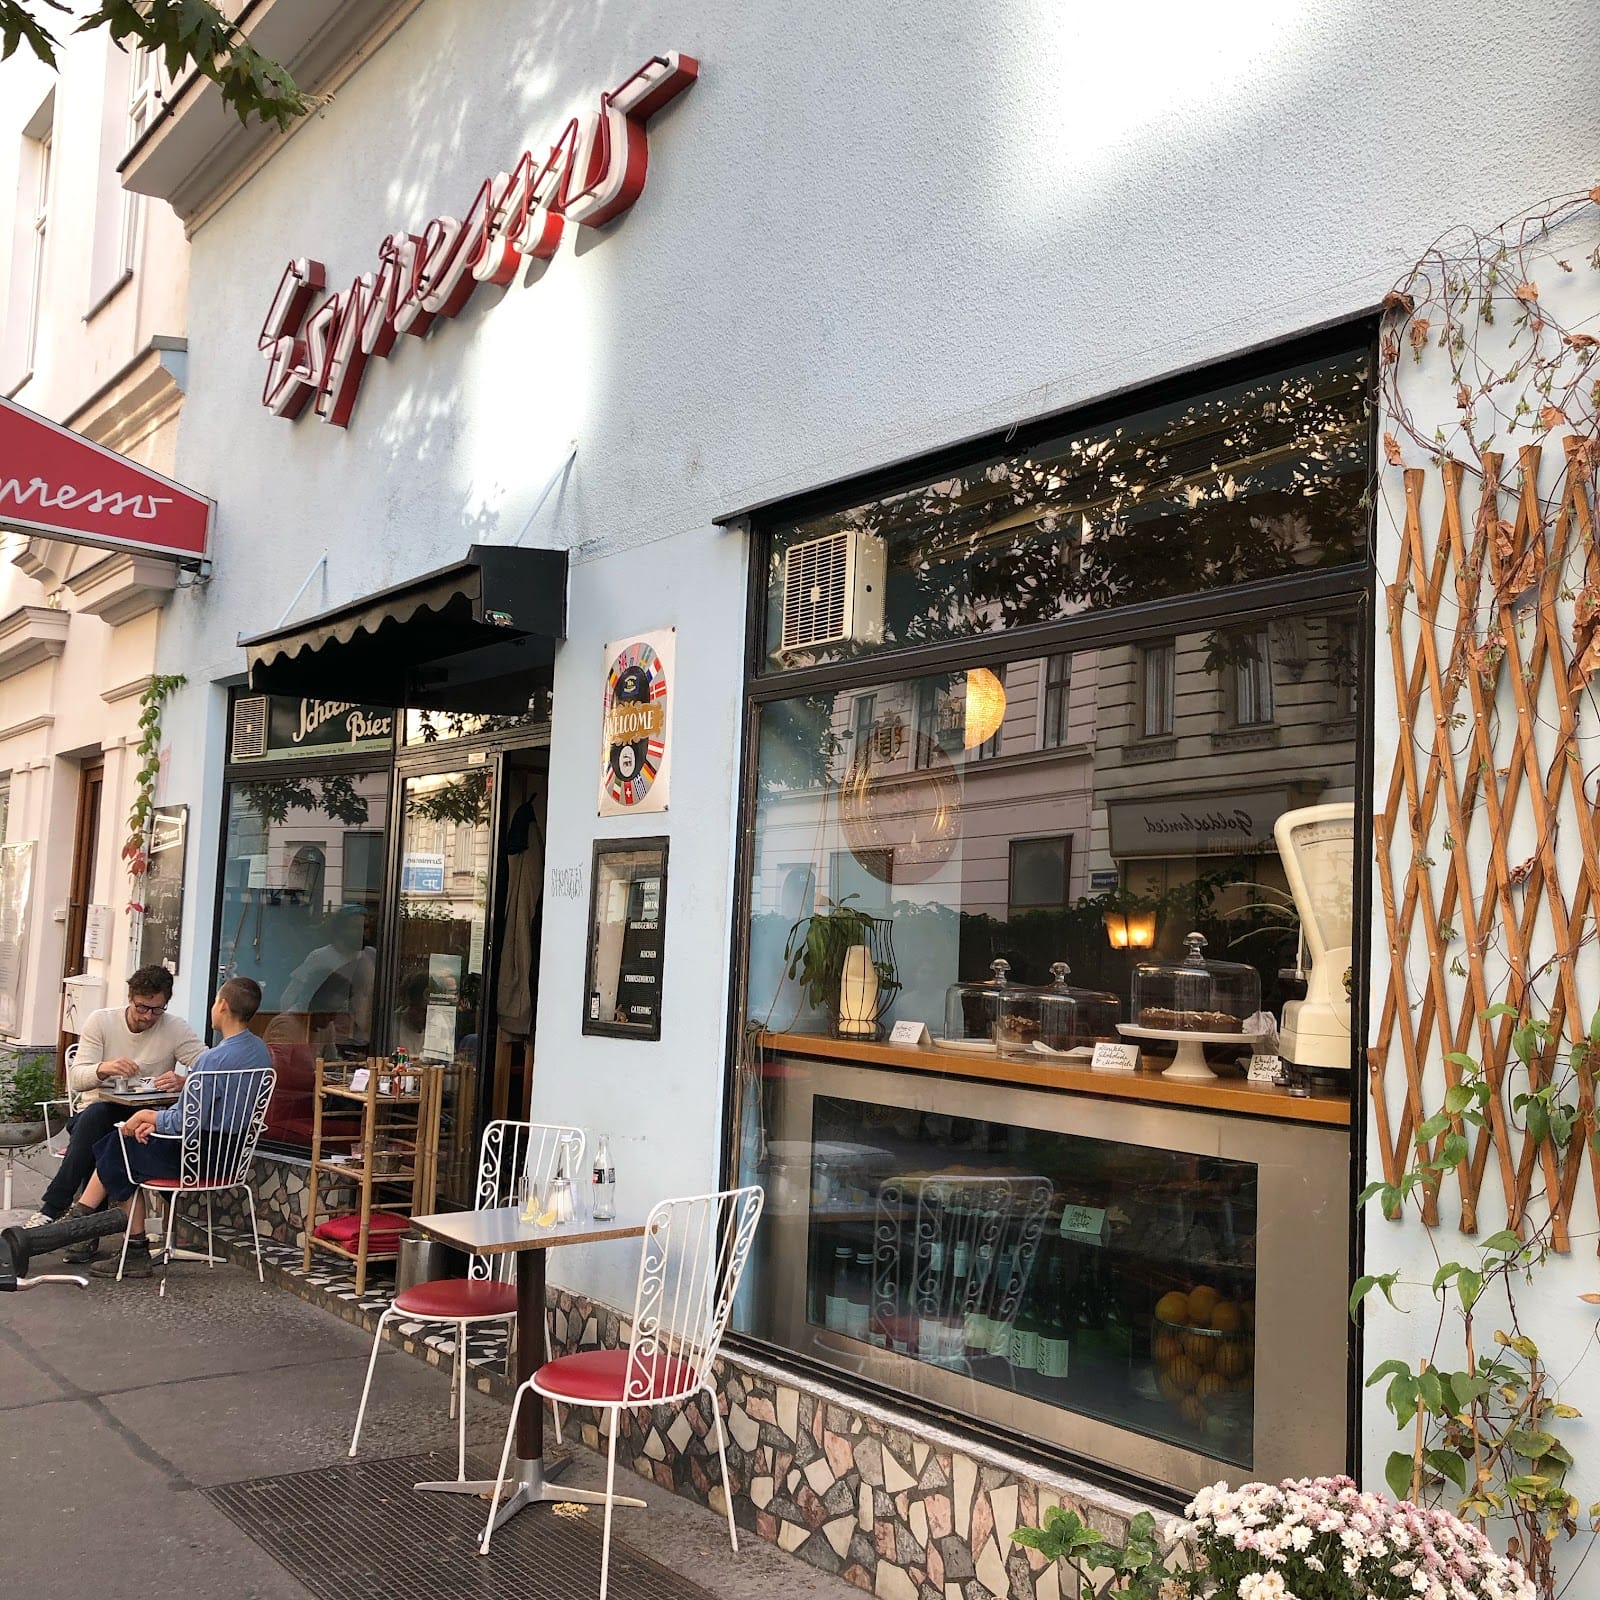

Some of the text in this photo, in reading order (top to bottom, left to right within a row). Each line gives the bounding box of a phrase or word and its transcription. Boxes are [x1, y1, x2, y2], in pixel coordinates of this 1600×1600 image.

[258, 49, 698, 429] Espresso
[346, 711, 392, 747] Bier
[604, 710, 654, 736] WELCOME
[631, 1005, 652, 1015] CATERING
